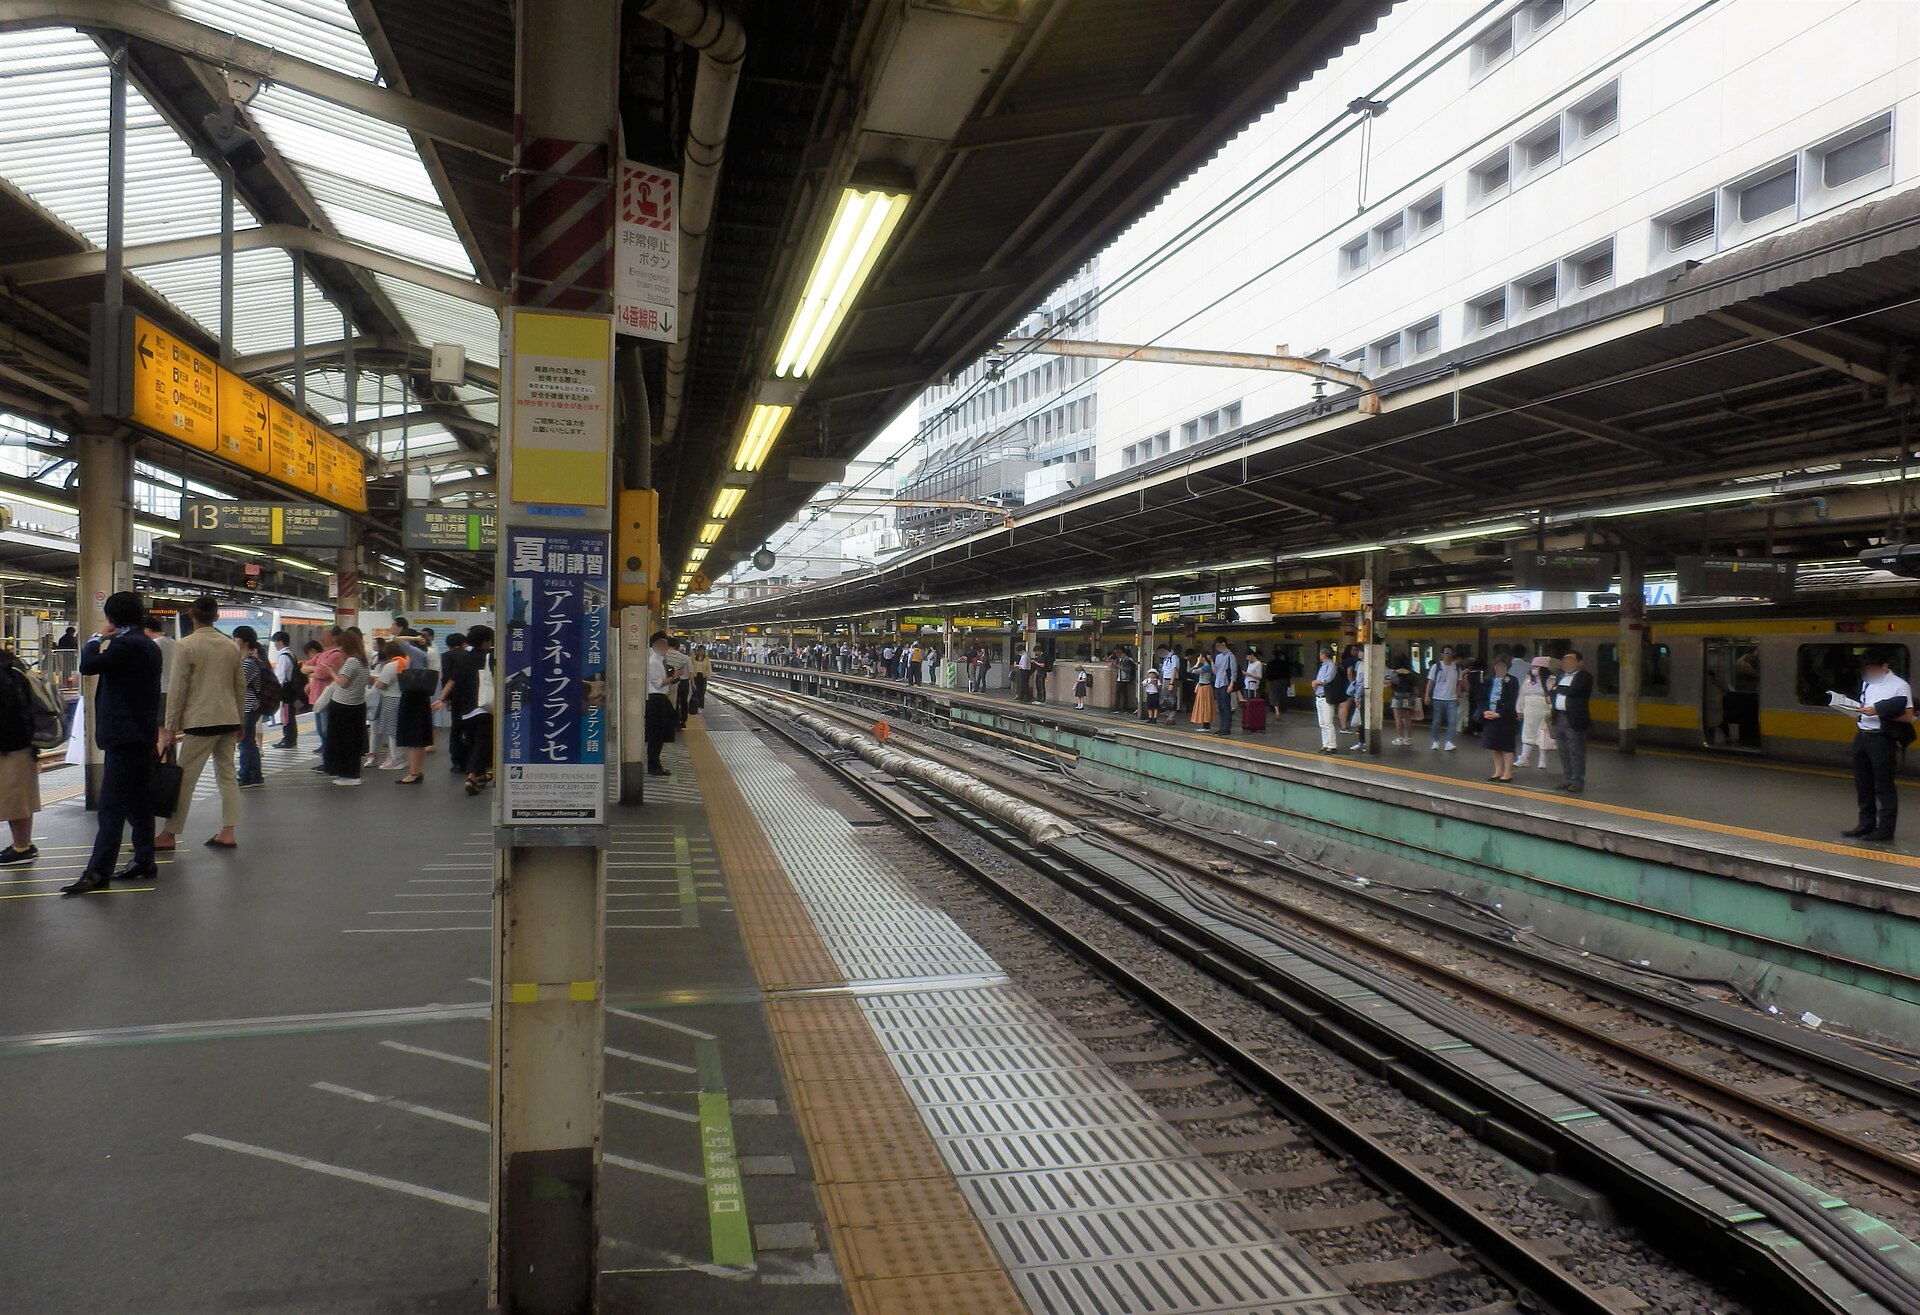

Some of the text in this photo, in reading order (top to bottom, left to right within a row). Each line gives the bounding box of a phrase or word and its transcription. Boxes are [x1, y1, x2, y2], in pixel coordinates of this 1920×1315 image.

[623, 230, 671, 254] 非常停止
[639, 254, 671, 269] ボタン
[629, 267, 670, 283] Emergency
[637, 280, 670, 295] train stop
[647, 291, 670, 303] button
[617, 304, 658, 330] 14番線用
[188, 504, 219, 530] 13
[481, 515, 497, 527] 山
[431, 523, 466, 533] 品川方面
[513, 536, 603, 575] 夏期講習
[1536, 555, 1546, 566] 15
[1777, 563, 1786, 573] 16
[904, 616, 912, 624] 15
[1074, 608, 1083, 617] 15
[1217, 612, 1225, 620] 16
[512, 627, 524, 652] 英語
[588, 604, 602, 665] フランス語
[539, 589, 573, 761] アテネ・フランセ
[586, 705, 599, 752] ラテン語
